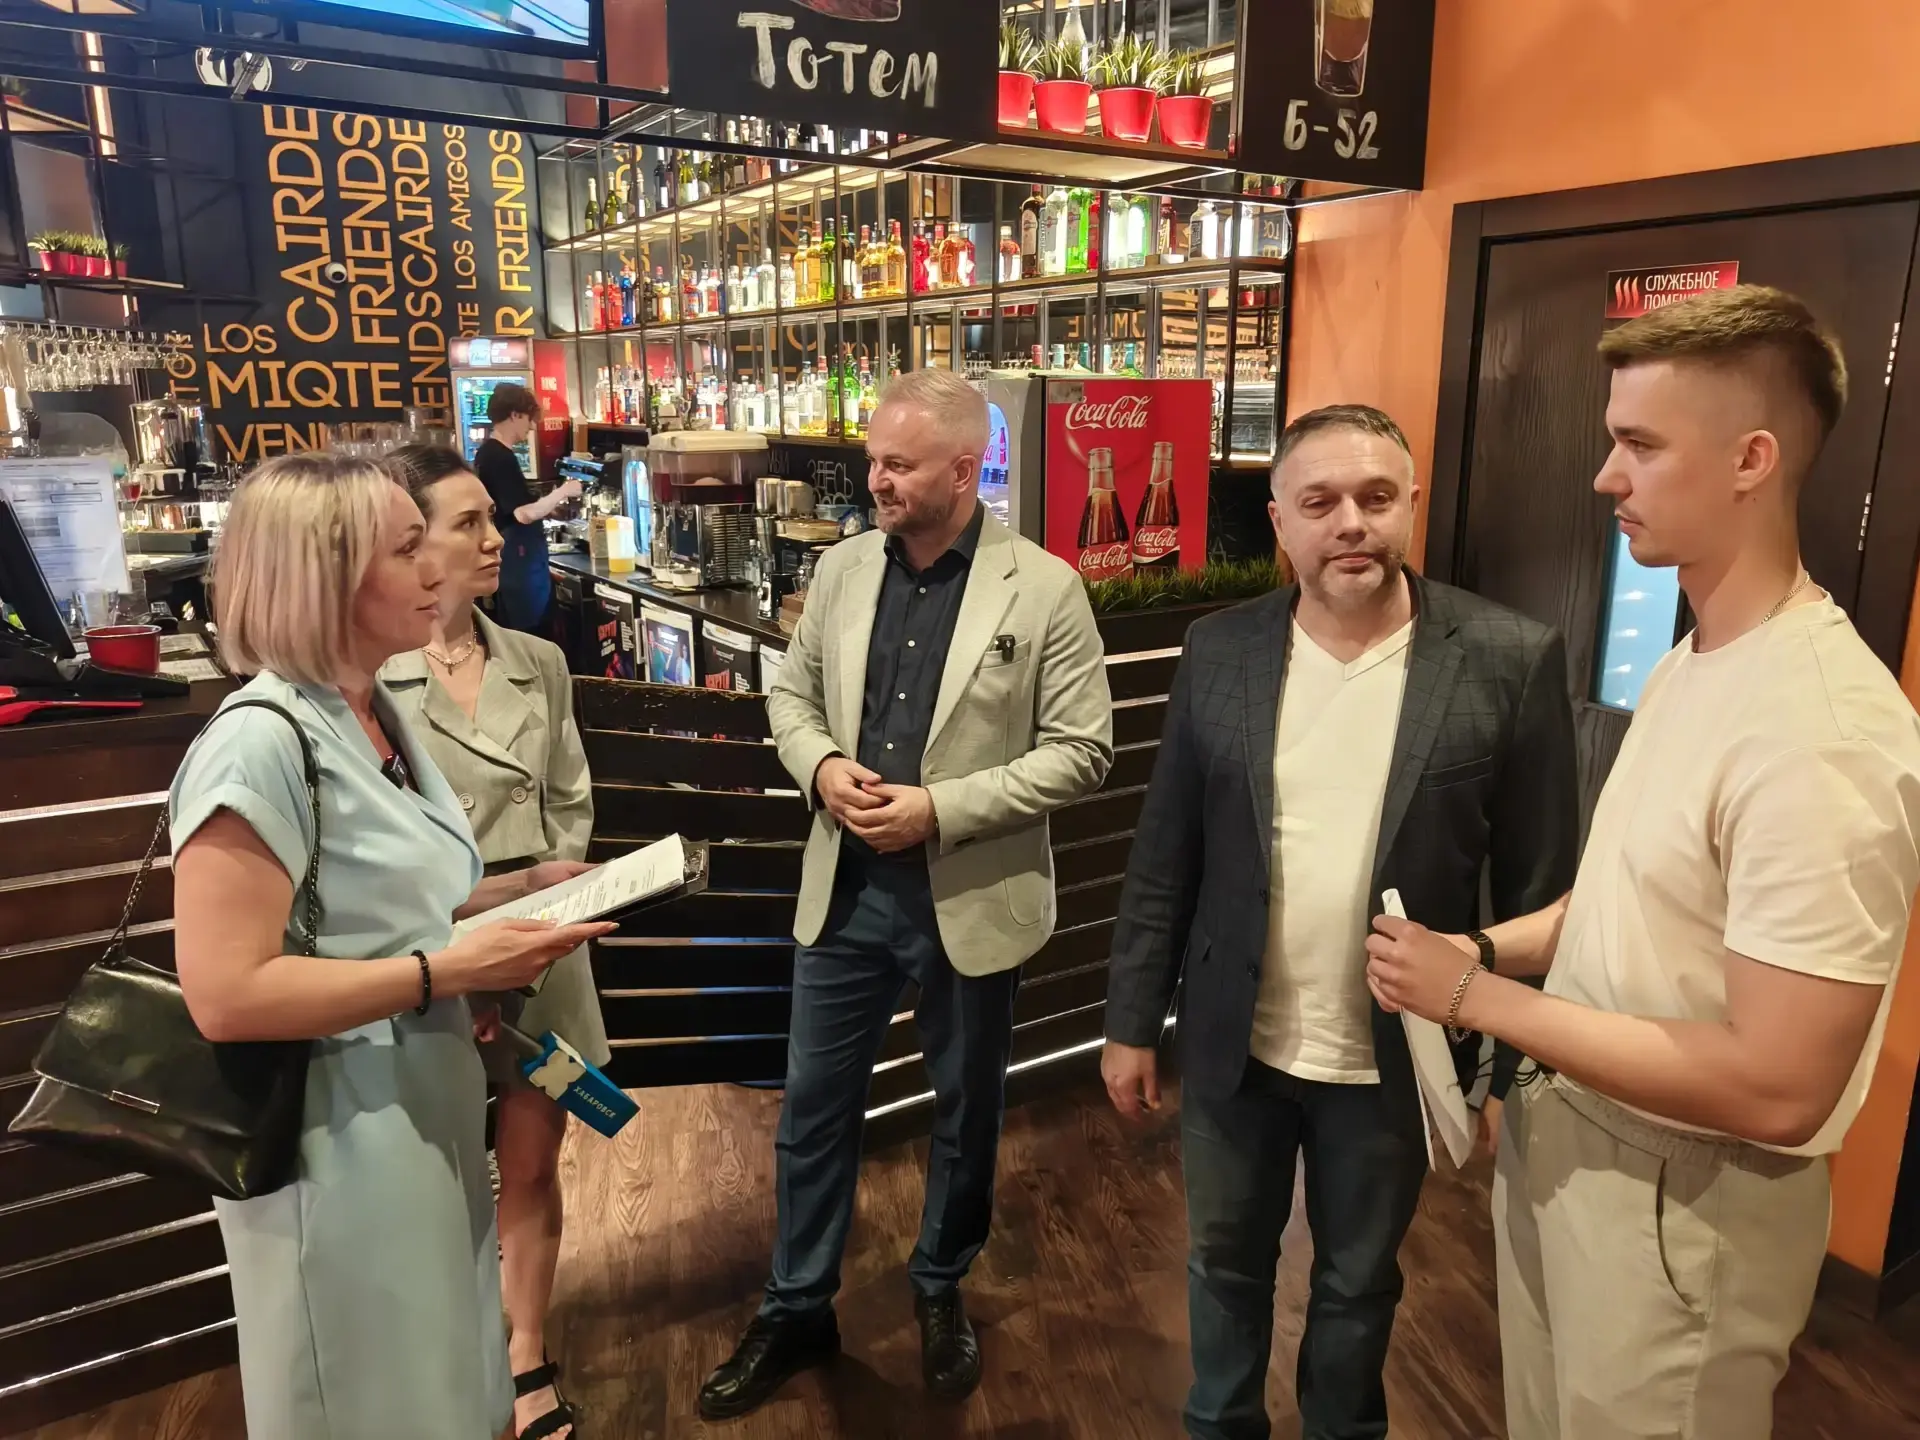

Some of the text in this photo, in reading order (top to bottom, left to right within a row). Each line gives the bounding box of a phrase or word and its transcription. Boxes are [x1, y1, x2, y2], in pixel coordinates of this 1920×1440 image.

[737, 12, 938, 108] Тотем
[443, 123, 473, 232] AMIGOS
[263, 104, 339, 343] CAIRDE
[332, 112, 401, 344] FRIENDS
[488, 128, 532, 292] FRIENDS
[453, 239, 477, 290] LOS
[1645, 270, 1719, 291] СЛУЖЕБНОЕ
[203, 322, 278, 355] LOS
[205, 360, 403, 409] MIQTE
[1065, 395, 1153, 430] Coca-Cola
[1078, 543, 1129, 572] Coca-Cola
[1133, 527, 1178, 547] Coca-Cola
